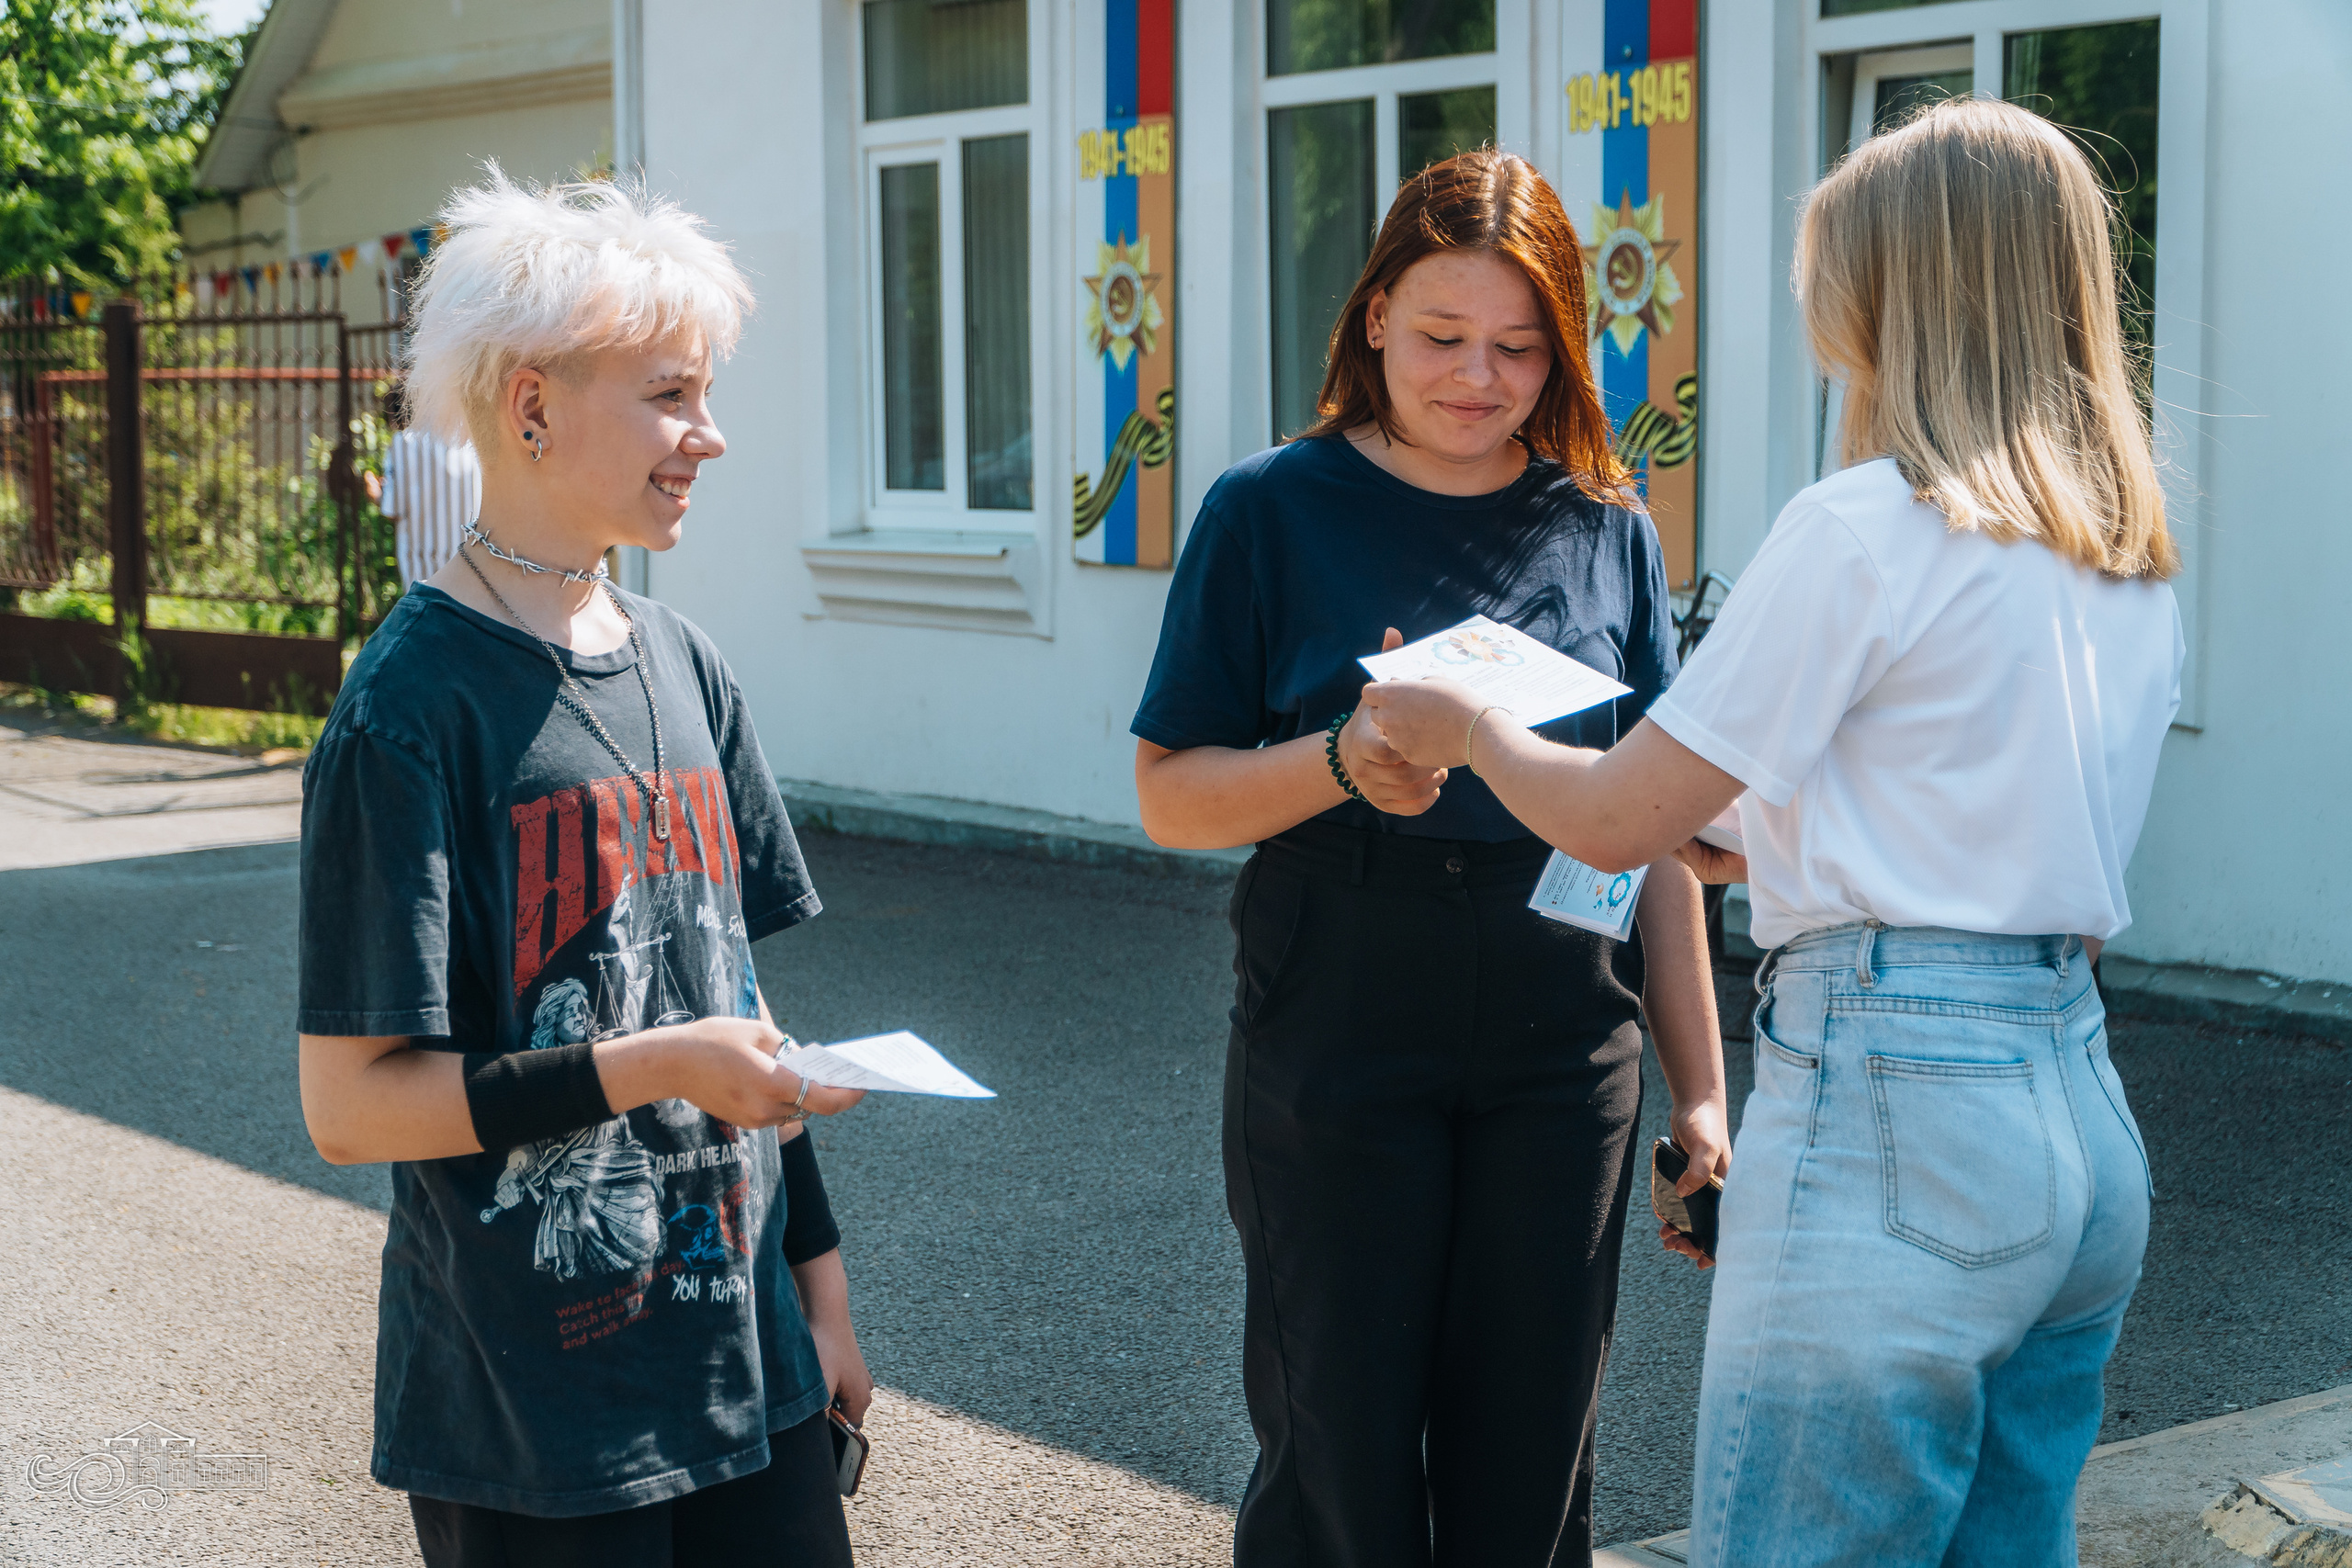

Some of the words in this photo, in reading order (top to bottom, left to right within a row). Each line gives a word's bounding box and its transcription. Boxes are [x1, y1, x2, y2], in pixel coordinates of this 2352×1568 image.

[1566, 62, 1692, 134] 1941-1945
[1078, 123, 1170, 180] 1941-1945
[655, 1150, 696, 1175] DARK
[556, 1301, 594, 1319] Wake
[597, 1295, 612, 1306] to
[615, 1281, 639, 1300] face
[662, 1262, 686, 1277] day.
[672, 1273, 701, 1302] YOU
[560, 1313, 600, 1335] Catch
[602, 1303, 626, 1320] this
[562, 1332, 589, 1350] and
[591, 1320, 621, 1340] walk
